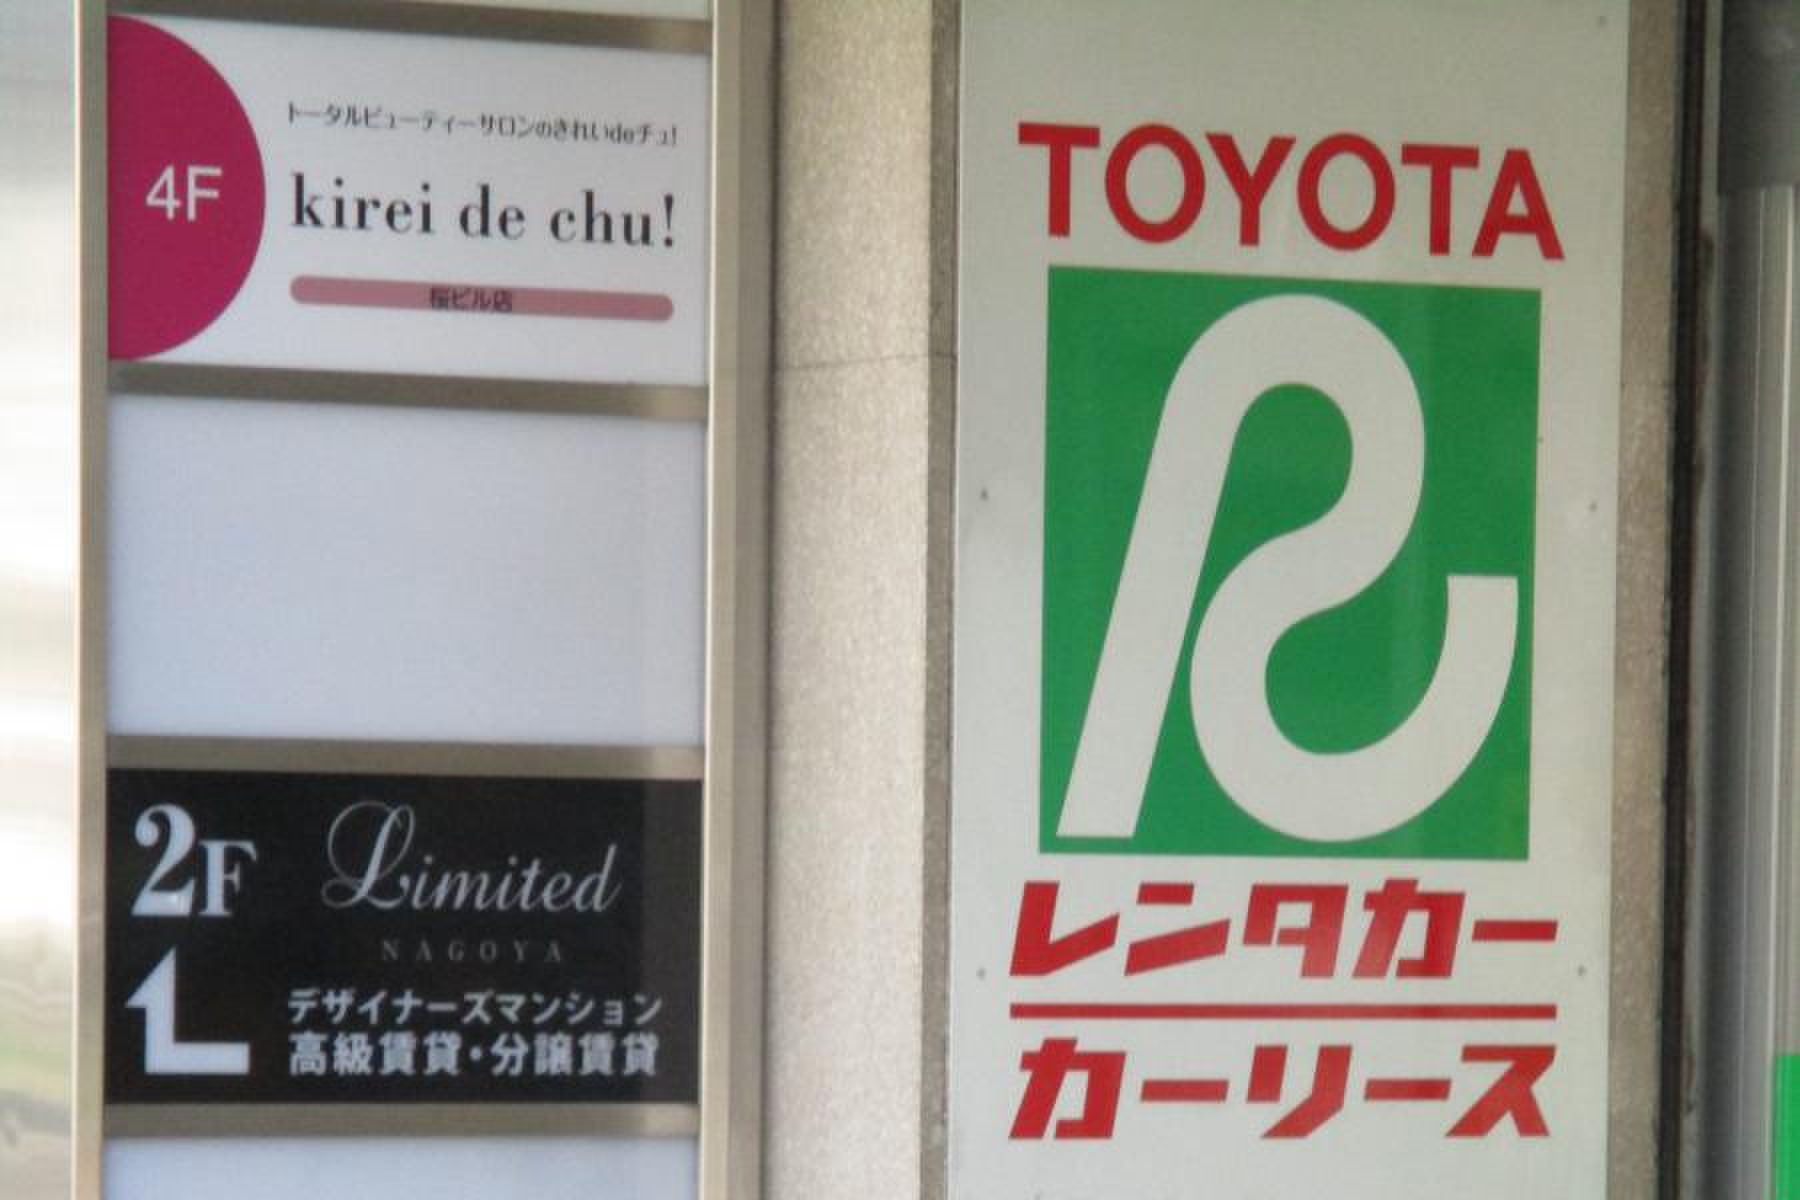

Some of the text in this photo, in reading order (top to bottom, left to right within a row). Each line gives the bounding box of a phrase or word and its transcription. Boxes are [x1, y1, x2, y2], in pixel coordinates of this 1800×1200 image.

[145, 165, 224, 222] 4F
[291, 172, 677, 248] kirei de chu!
[1018, 122, 1565, 261] TOYOTA
[131, 803, 258, 918] 2F
[321, 800, 621, 913] Limited
[380, 939, 563, 963] NAGOYA
[1008, 878, 1559, 979] レンタカー
[288, 988, 663, 1026] デザイナーズマンション
[1008, 1036, 1558, 1140] カーリース
